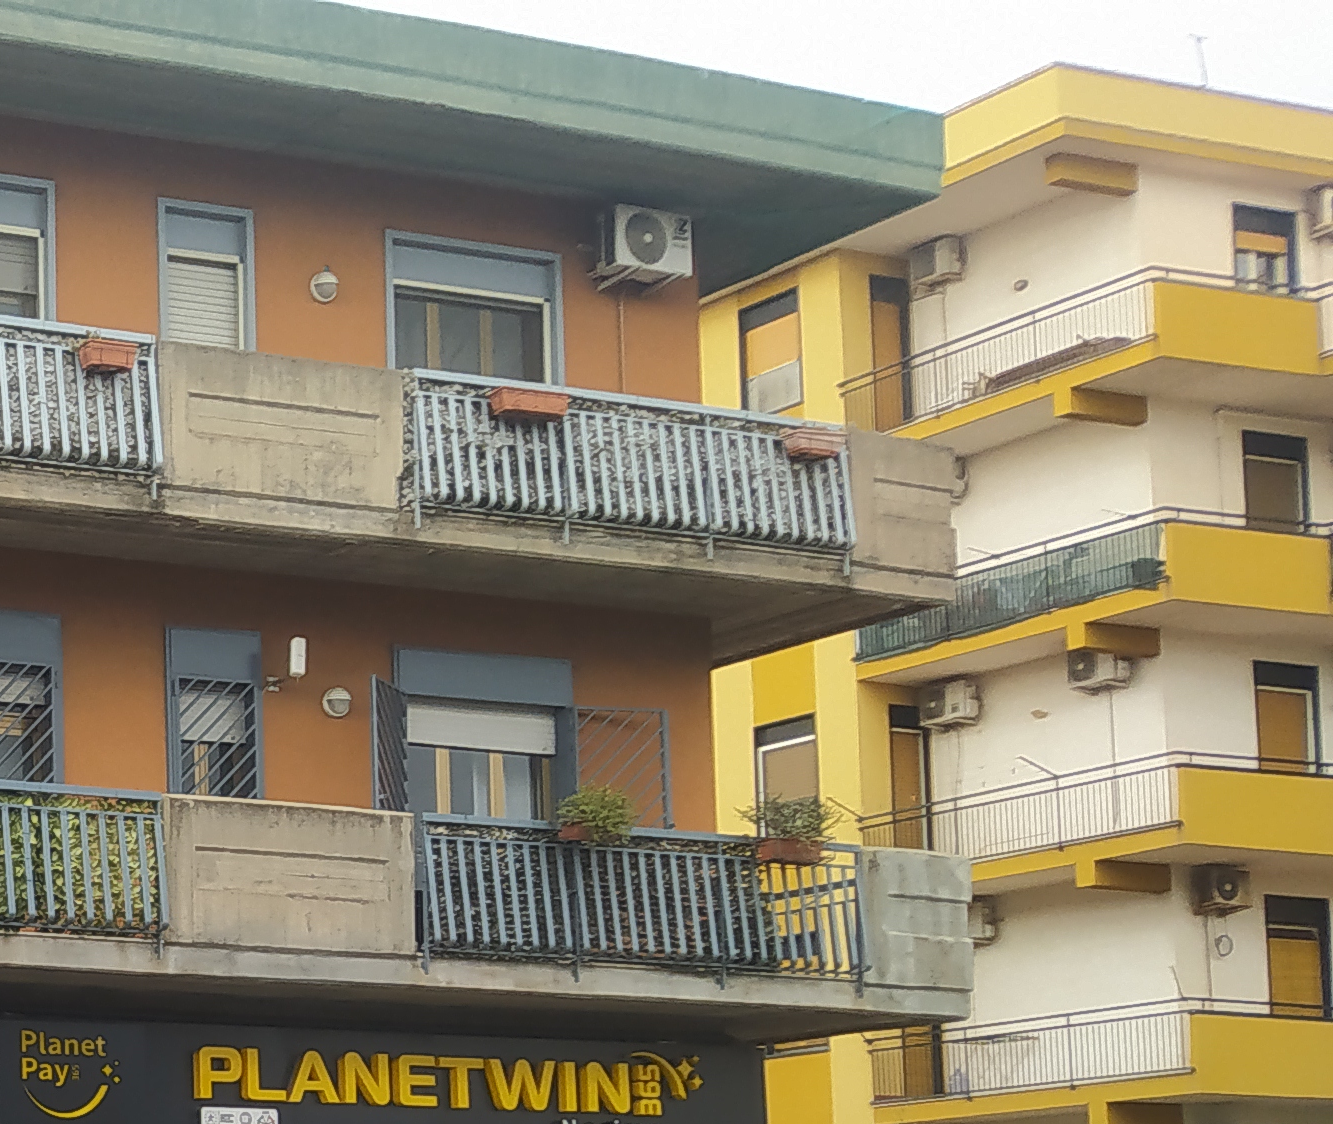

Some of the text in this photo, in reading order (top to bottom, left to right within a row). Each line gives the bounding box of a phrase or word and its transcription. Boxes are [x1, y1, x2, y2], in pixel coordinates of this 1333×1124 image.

[20, 1029, 107, 1057] Planet
[20, 1057, 69, 1087] Pay
[193, 1046, 631, 1115] PLANETWIN
